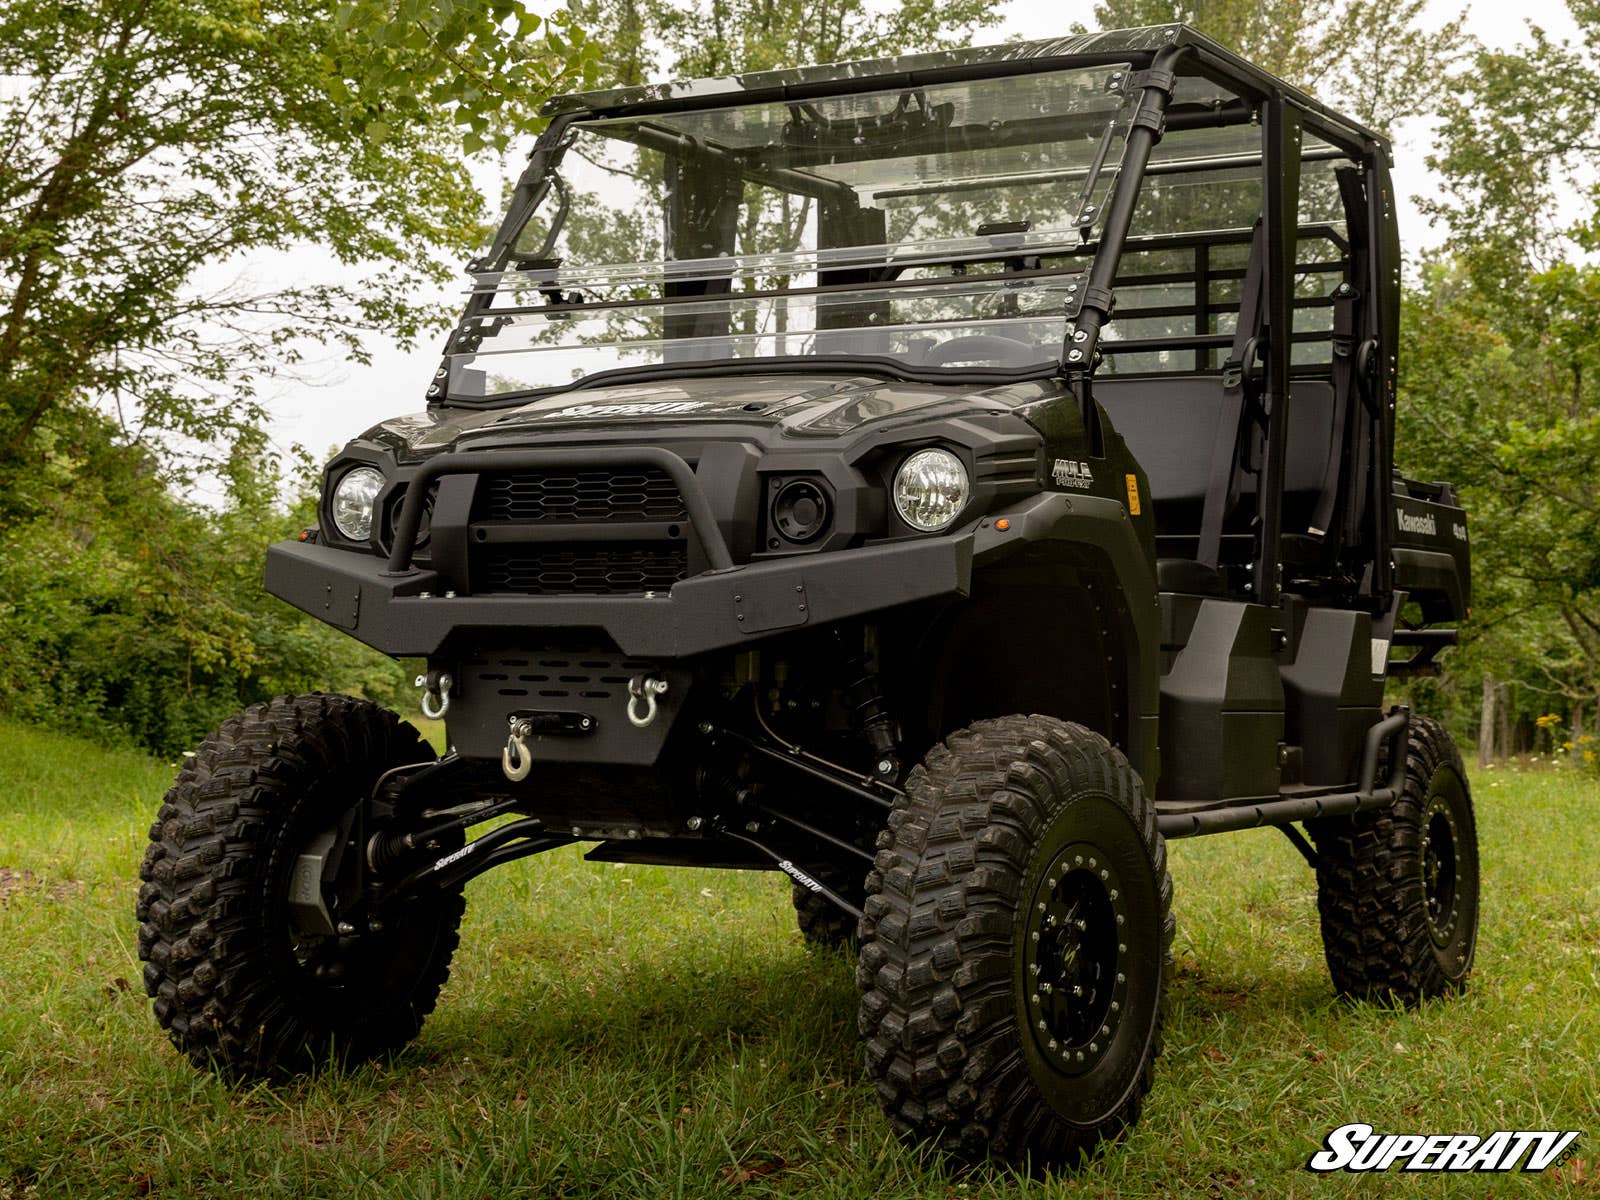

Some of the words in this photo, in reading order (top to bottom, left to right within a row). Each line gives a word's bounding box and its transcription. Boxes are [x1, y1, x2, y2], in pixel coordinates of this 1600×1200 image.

[1051, 458, 1093, 481] MULE
[1396, 507, 1437, 536] Kawasaki
[778, 860, 823, 893] SUPERATV
